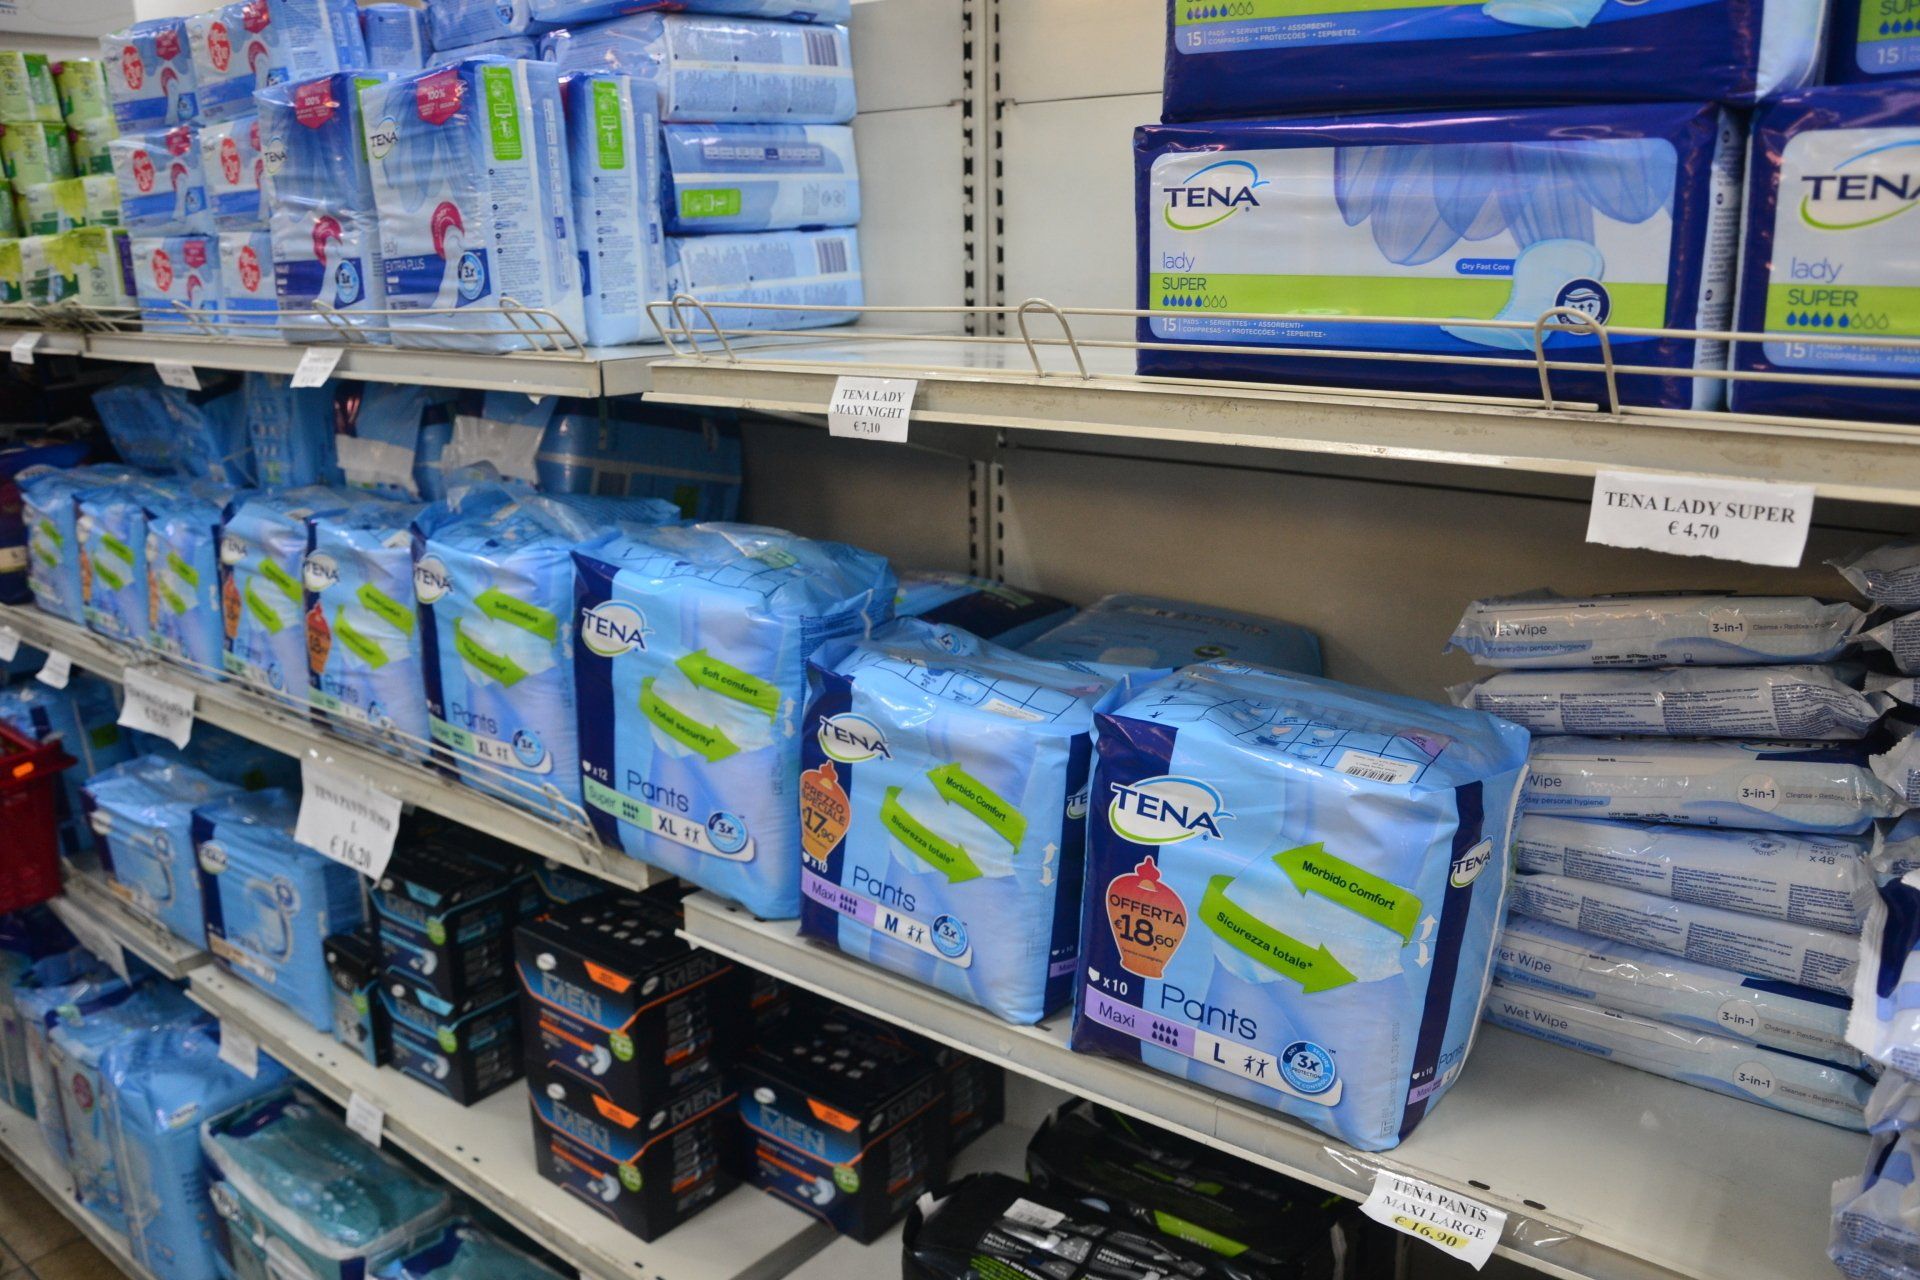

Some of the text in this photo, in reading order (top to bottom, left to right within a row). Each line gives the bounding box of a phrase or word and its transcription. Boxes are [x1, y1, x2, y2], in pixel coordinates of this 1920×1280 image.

[1186, 32, 1202, 47] 15
[1878, 47, 1898, 64] 15
[369, 131, 399, 148] TENA
[1163, 186, 1260, 208] TENA
[1162, 252, 1195, 272] lady
[1461, 262, 1511, 272] Dry Fast Core
[1790, 257, 1843, 284] lady
[1162, 277, 1207, 291] SUPER
[1788, 289, 1858, 307] SUPER
[1162, 318, 1176, 332] 15
[842, 389, 905, 403] TENA LADY
[833, 404, 905, 419] MAXI NIGHT
[861, 421, 881, 434] 7,10
[1605, 491, 1796, 524] TENA LADY SUPER
[1668, 521, 1720, 540] € 4,70
[305, 559, 341, 583] TENA
[415, 566, 454, 592] TENA
[583, 610, 646, 650] TENA
[1513, 624, 1547, 638] Wipe
[1712, 623, 1744, 633] 3-in-1
[702, 666, 758, 697] Soft comfort
[451, 701, 498, 735] Pants
[652, 705, 674, 726] Total
[819, 716, 891, 759] TENA
[587, 785, 616, 809] Super
[626, 769, 690, 813] Pants
[803, 781, 845, 815] PREZZO
[945, 776, 1007, 823] Morbido Comfort
[1070, 794, 1088, 807] TE
[1742, 788, 1775, 799] 3-in-1
[1785, 791, 1812, 799] Cleanse
[1111, 784, 1222, 838] TENA
[658, 815, 678, 837] XL
[718, 822, 735, 835] 3x
[890, 815, 928, 848] Sicurezza
[1454, 850, 1491, 875] TENA
[812, 880, 837, 903] Maxi
[853, 865, 916, 912] Pants
[1302, 860, 1396, 910] Morbido Comfort
[1109, 894, 1185, 928] OFFERTA
[884, 913, 899, 933] M
[942, 924, 957, 939] 3x
[1216, 912, 1271, 952] Sicurezza
[1499, 948, 1552, 973] et Wipe
[541, 972, 601, 1020] MEN
[1103, 977, 1128, 996] x10
[1099, 1002, 1135, 1029] Maxi
[1161, 983, 1258, 1041] Pants
[1503, 1003, 1569, 1030] Wet Wipe
[1721, 1011, 1755, 1027] 3-in-1
[1213, 1042, 1225, 1064] L
[1297, 1054, 1320, 1072] 3x
[1738, 1072, 1771, 1089] 3-in-1
[671, 1077, 723, 1122] MEN
[552, 1100, 611, 1152] MEN
[760, 1104, 826, 1155] MEN
[1392, 1178, 1488, 1222] TENA PANTS
[1382, 1195, 1486, 1240] MAXI LARGE
[1394, 1216, 1405, 1226] €
